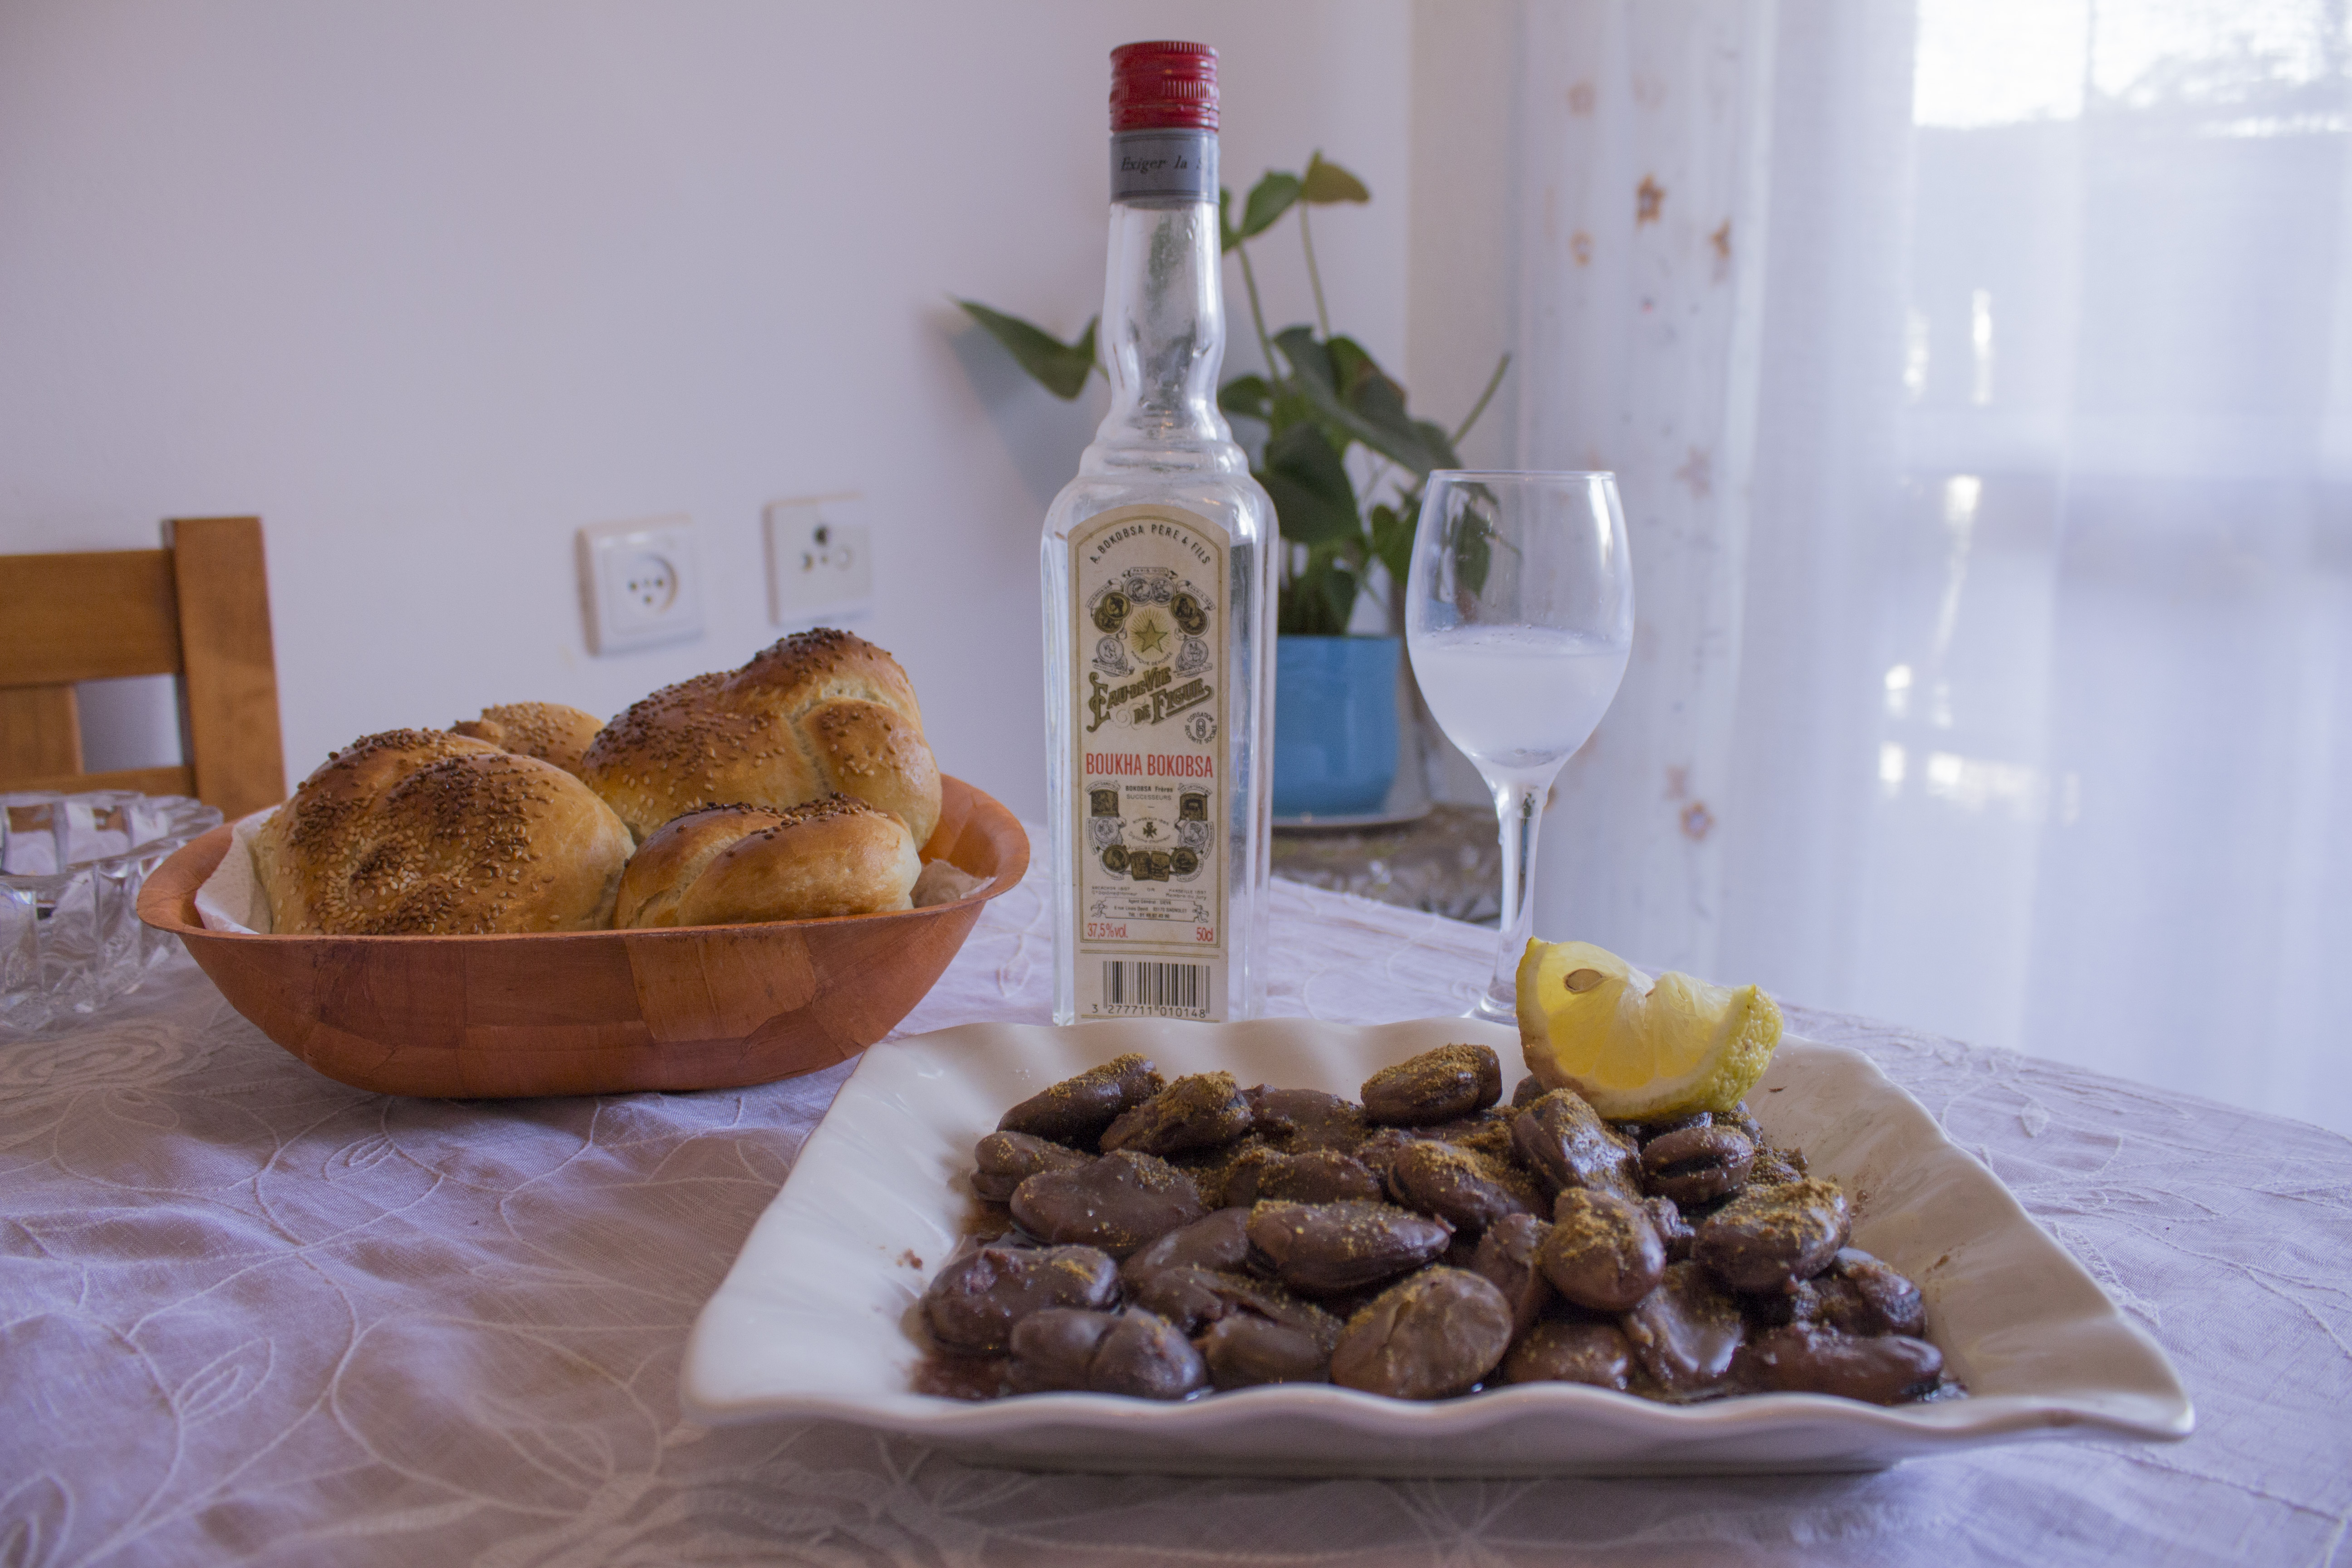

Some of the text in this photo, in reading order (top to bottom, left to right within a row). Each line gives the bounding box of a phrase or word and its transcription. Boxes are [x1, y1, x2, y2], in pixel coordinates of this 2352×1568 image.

[1121, 157, 1167, 174] Exiger
[1174, 155, 1187, 169] la
[1089, 555, 1101, 565] A.
[1097, 524, 1145, 555] BOKOBSA
[1181, 536, 1189, 546] &
[1191, 542, 1211, 565] FILS
[1149, 677, 1215, 725] FIGUE
[1186, 711, 1215, 723] COTISATION
[1204, 725, 1217, 744] SOCIALE
[1086, 753, 1214, 779] BOUKHA BOKOBSA
[1092, 1003, 1206, 1018] 3 277711 010148
